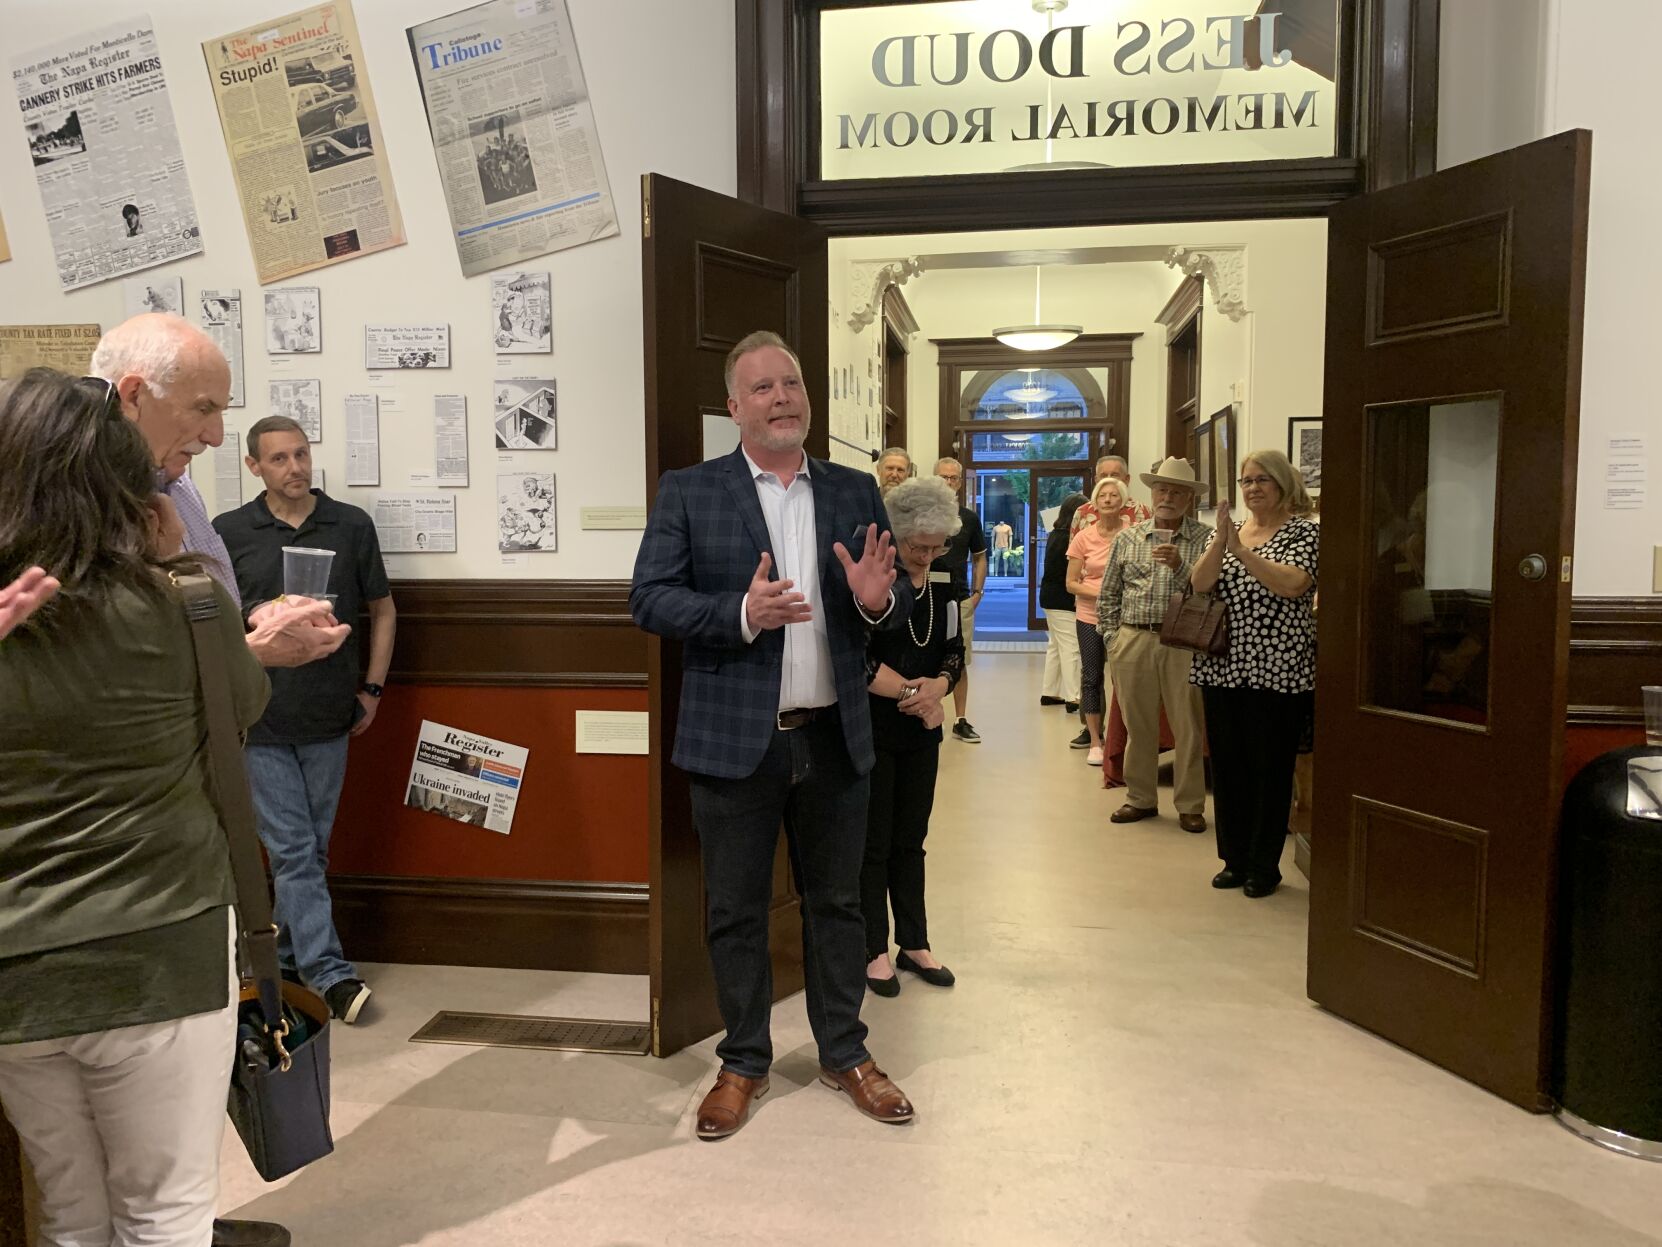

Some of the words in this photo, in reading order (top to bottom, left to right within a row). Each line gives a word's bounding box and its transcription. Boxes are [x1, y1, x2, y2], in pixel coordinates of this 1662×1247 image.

[273, 20, 329, 47] Sentinel
[39, 71, 58, 85] The
[61, 63, 86, 77] Napa
[89, 49, 130, 70] Register
[422, 37, 503, 70] Tribune
[20, 88, 61, 111] CANNERY
[63, 78, 94, 98] STRIKE
[96, 71, 117, 87] HITS
[117, 57, 161, 80] FARMERS
[220, 57, 279, 86] Stupid!
[23, 329, 34, 338] TAX
[38, 329, 52, 338] RATE
[55, 329, 71, 338] FIXED
[74, 328, 81, 337] AT
[431, 754, 449, 763] stayed
[432, 747, 460, 759] Frenchman
[444, 732, 504, 758] Register
[413, 772, 451, 791] Ukraine
[452, 784, 490, 803] invaded
